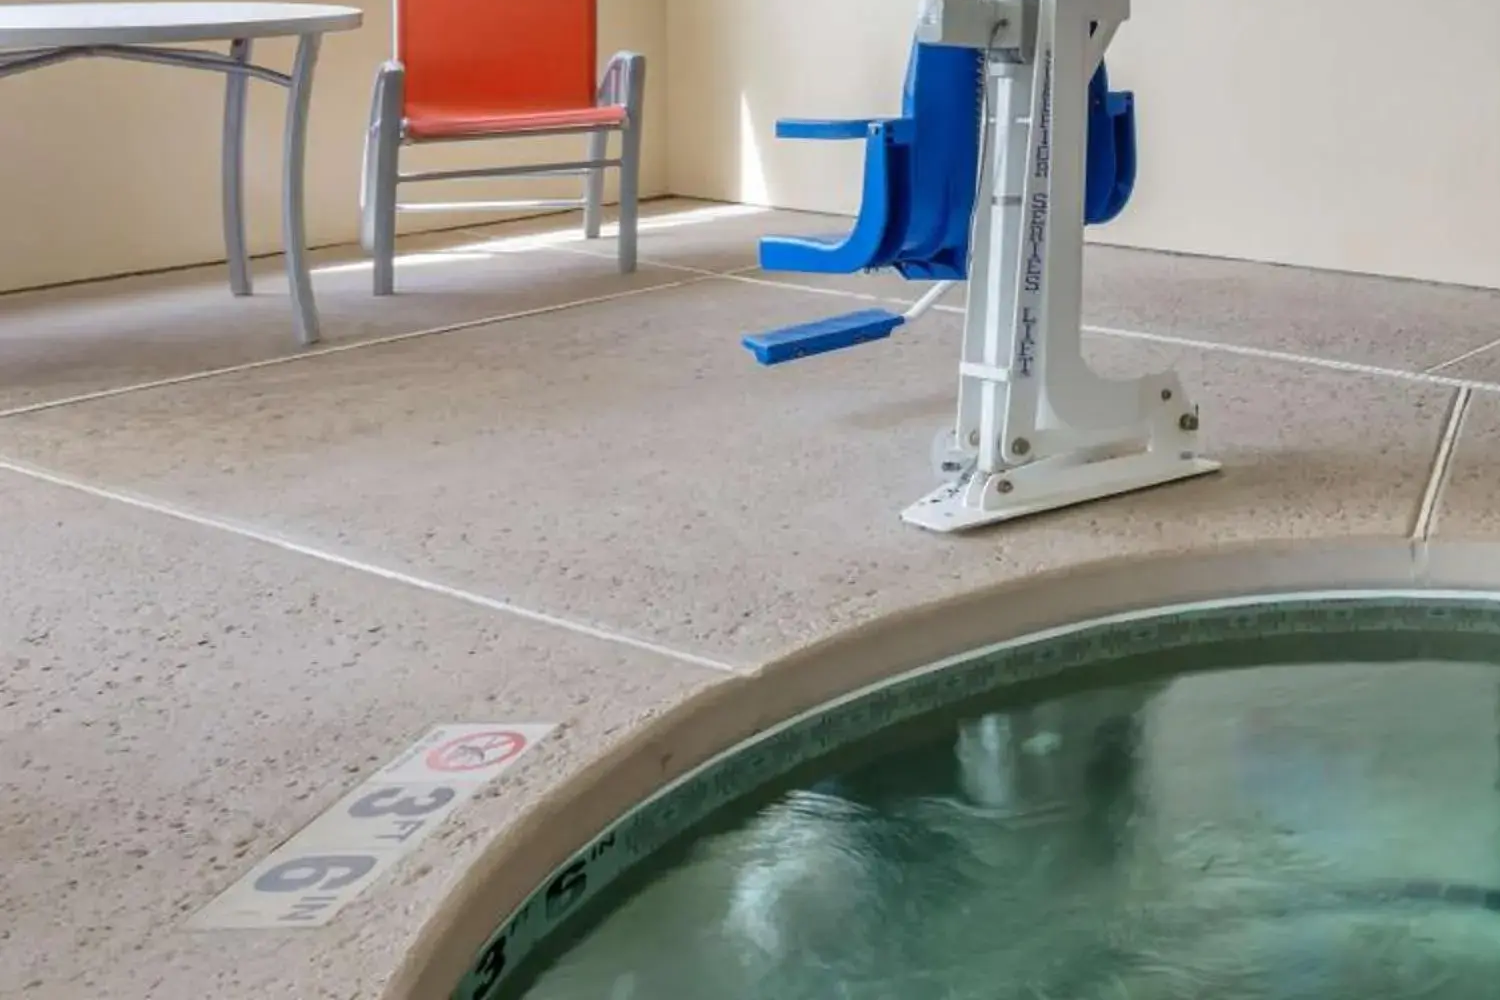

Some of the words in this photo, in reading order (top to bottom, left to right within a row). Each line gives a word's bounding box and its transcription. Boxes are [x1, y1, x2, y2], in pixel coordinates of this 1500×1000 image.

[1025, 193, 1048, 291] SERIES
[347, 786, 456, 819] 3
[254, 854, 378, 892] 6
